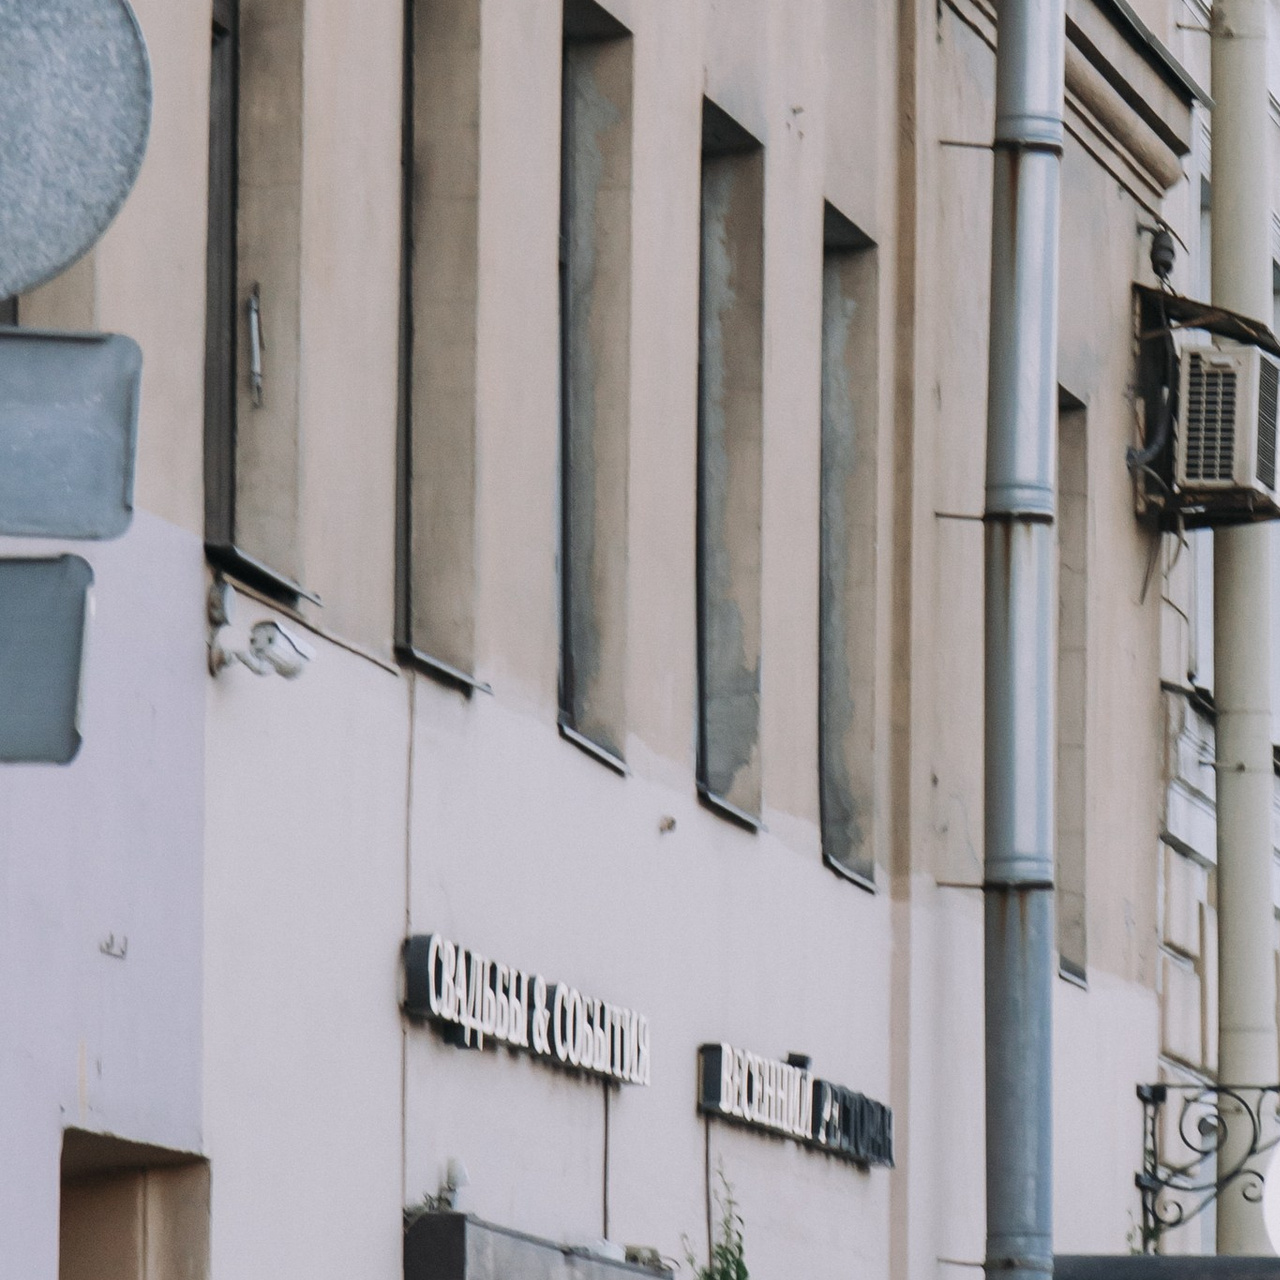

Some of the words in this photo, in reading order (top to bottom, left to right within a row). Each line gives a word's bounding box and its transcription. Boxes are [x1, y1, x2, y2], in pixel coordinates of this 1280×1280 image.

[428, 933, 530, 1052] СВАДЬБЫ
[554, 982, 650, 1087] СОБЫТИЯ
[719, 1041, 814, 1140] ВЕСЕННИЙ
